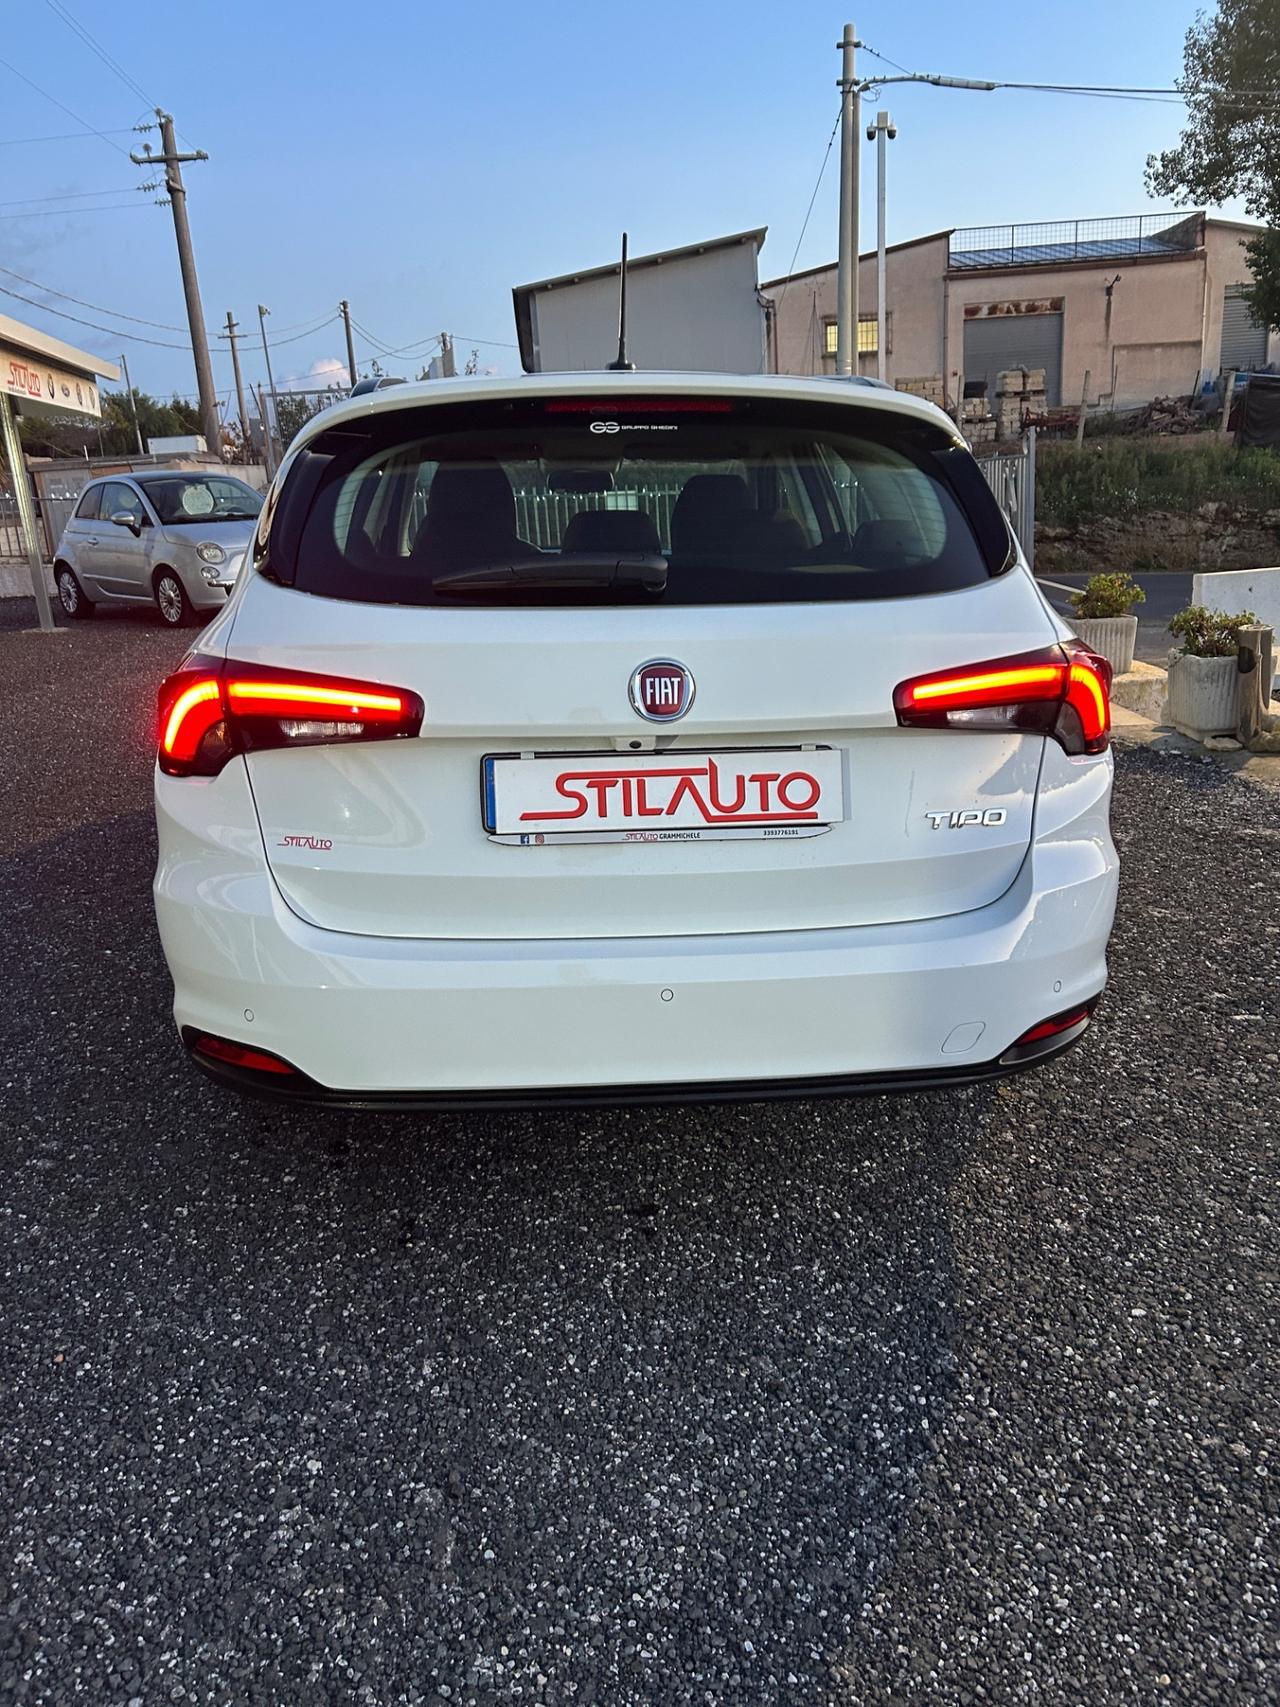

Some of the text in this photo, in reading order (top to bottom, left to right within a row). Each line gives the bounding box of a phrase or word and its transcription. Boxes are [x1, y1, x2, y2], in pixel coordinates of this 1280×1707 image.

[645, 677, 681, 705] FIAT
[519, 756, 821, 824] STILAUTO
[925, 808, 1007, 830] TIPO
[277, 836, 333, 851] STILAUTO
[622, 832, 701, 843] STILAUTO GRAMMICHELE
